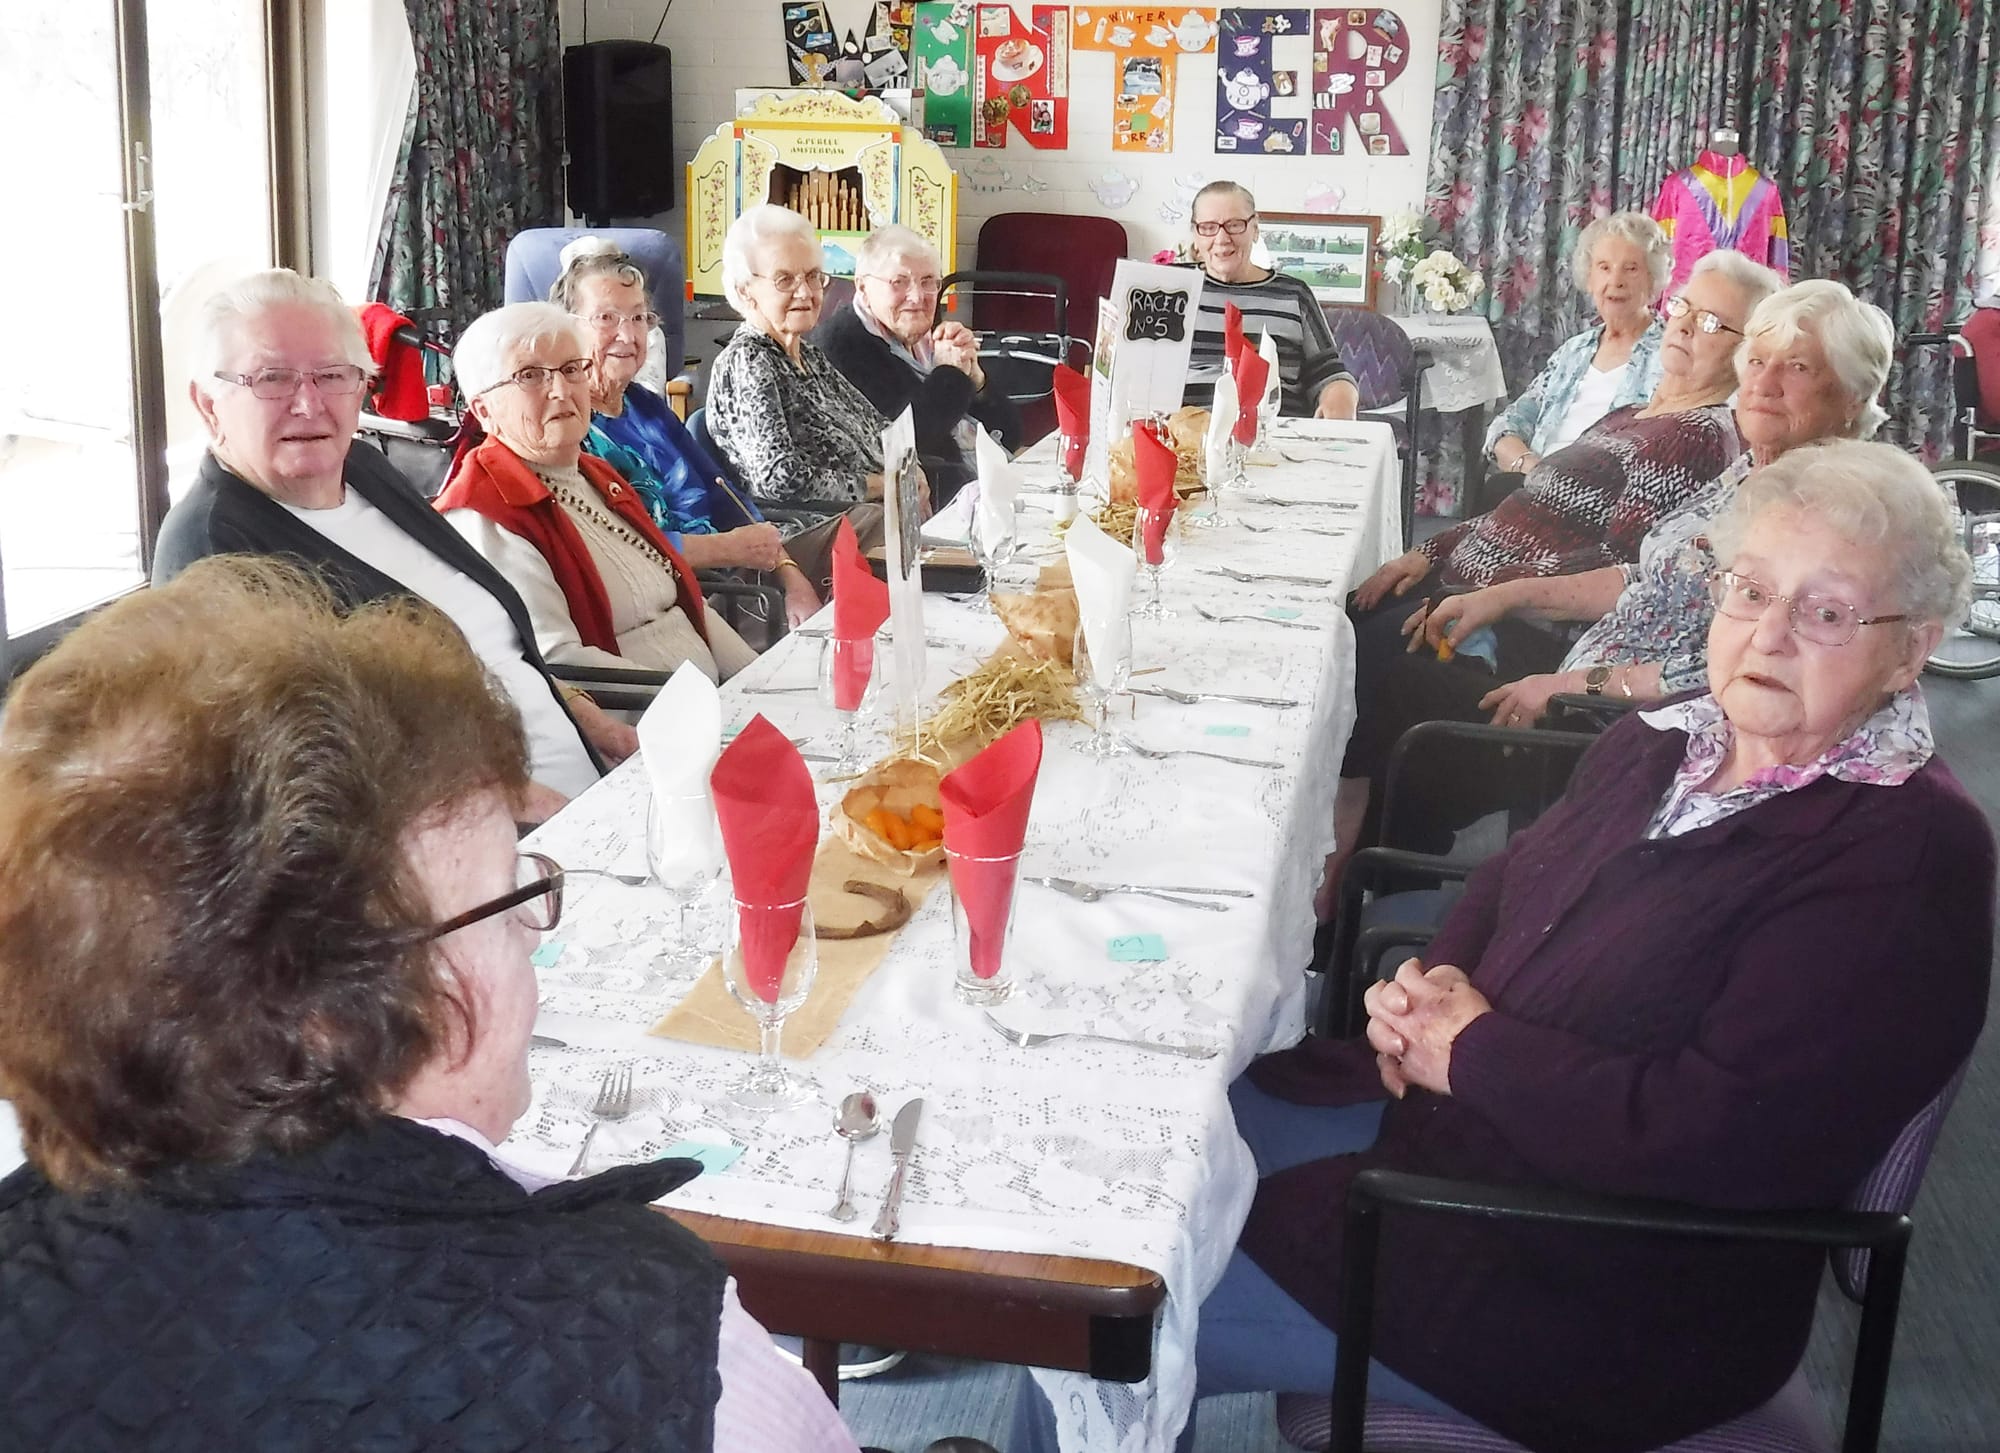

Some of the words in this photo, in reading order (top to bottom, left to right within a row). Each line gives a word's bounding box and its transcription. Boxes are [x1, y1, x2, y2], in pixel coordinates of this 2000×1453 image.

[1108, 10, 1166, 24] WINTER
[782, 1, 1411, 156] WINTER
[1132, 290, 1173, 313] RACE
[1154, 317, 1169, 337] 5
